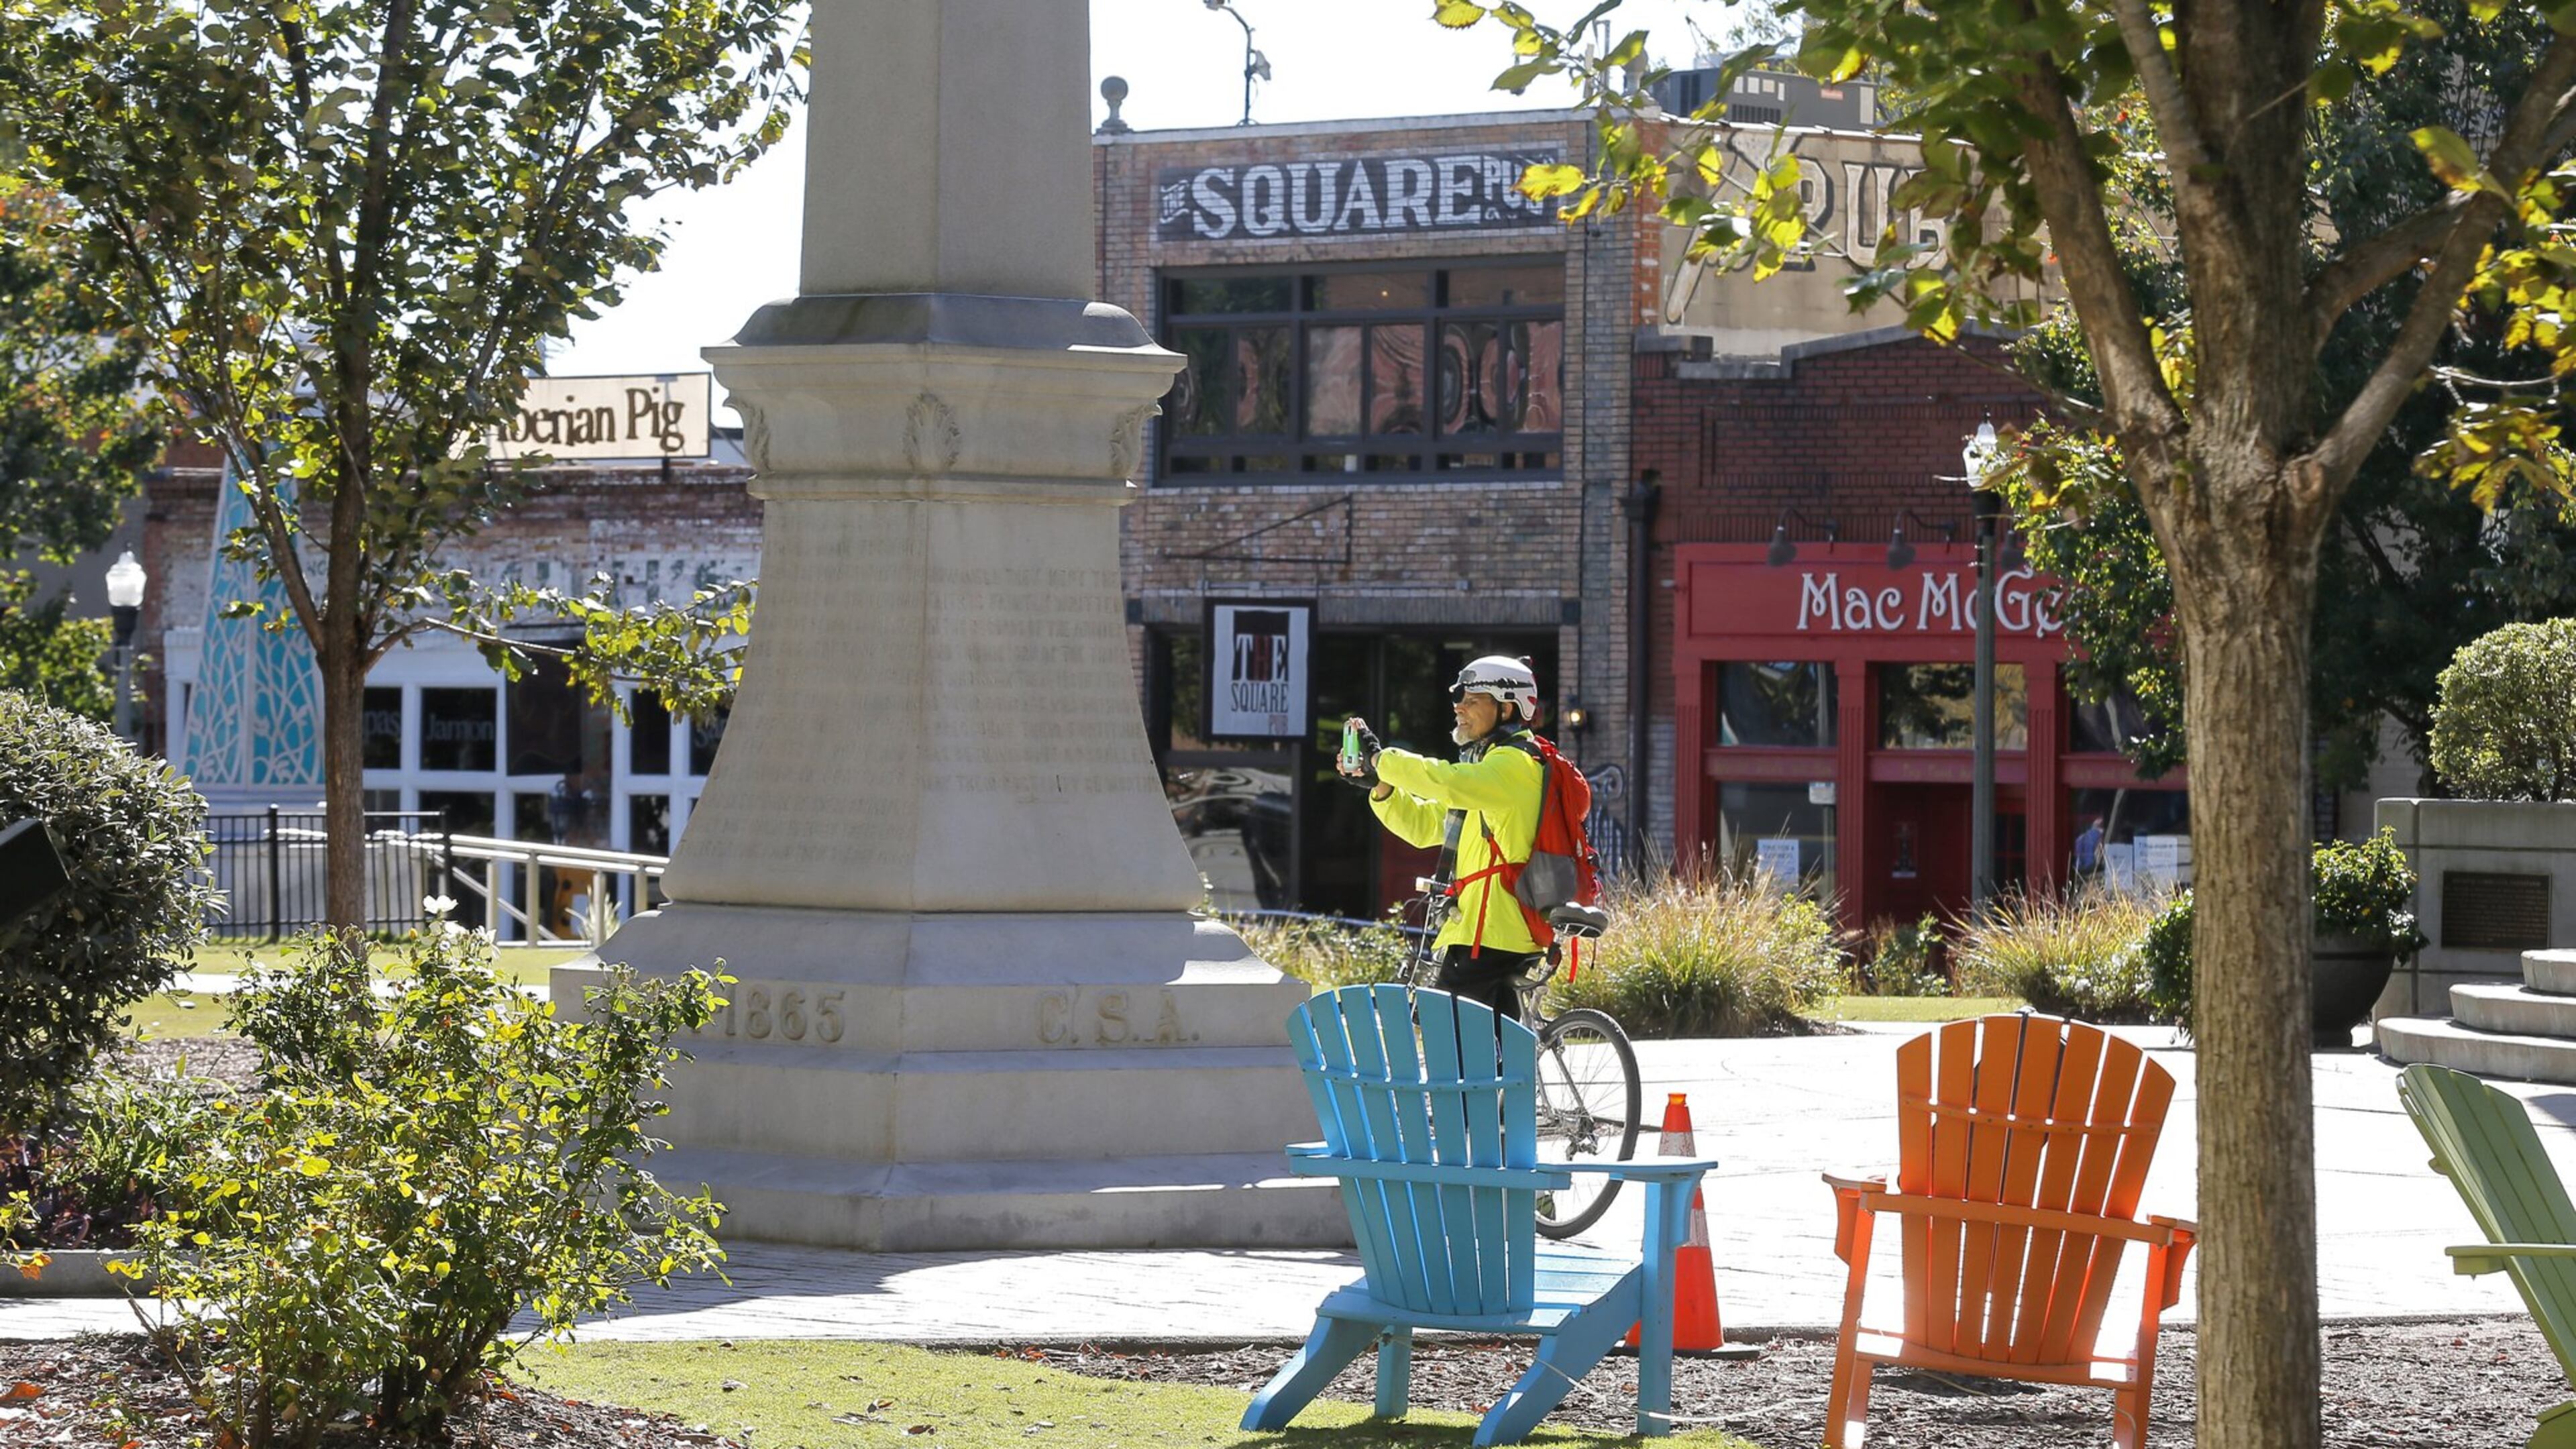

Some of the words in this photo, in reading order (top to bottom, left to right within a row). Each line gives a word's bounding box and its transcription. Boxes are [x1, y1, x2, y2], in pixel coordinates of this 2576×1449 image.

[1160, 180, 1189, 223] THE
[1191, 155, 1481, 238] SQUARE
[626, 387, 684, 451] Pig
[1796, 572, 1906, 631] Mac
[1235, 634, 1288, 682] THE
[1230, 682, 1289, 714] SQUARE
